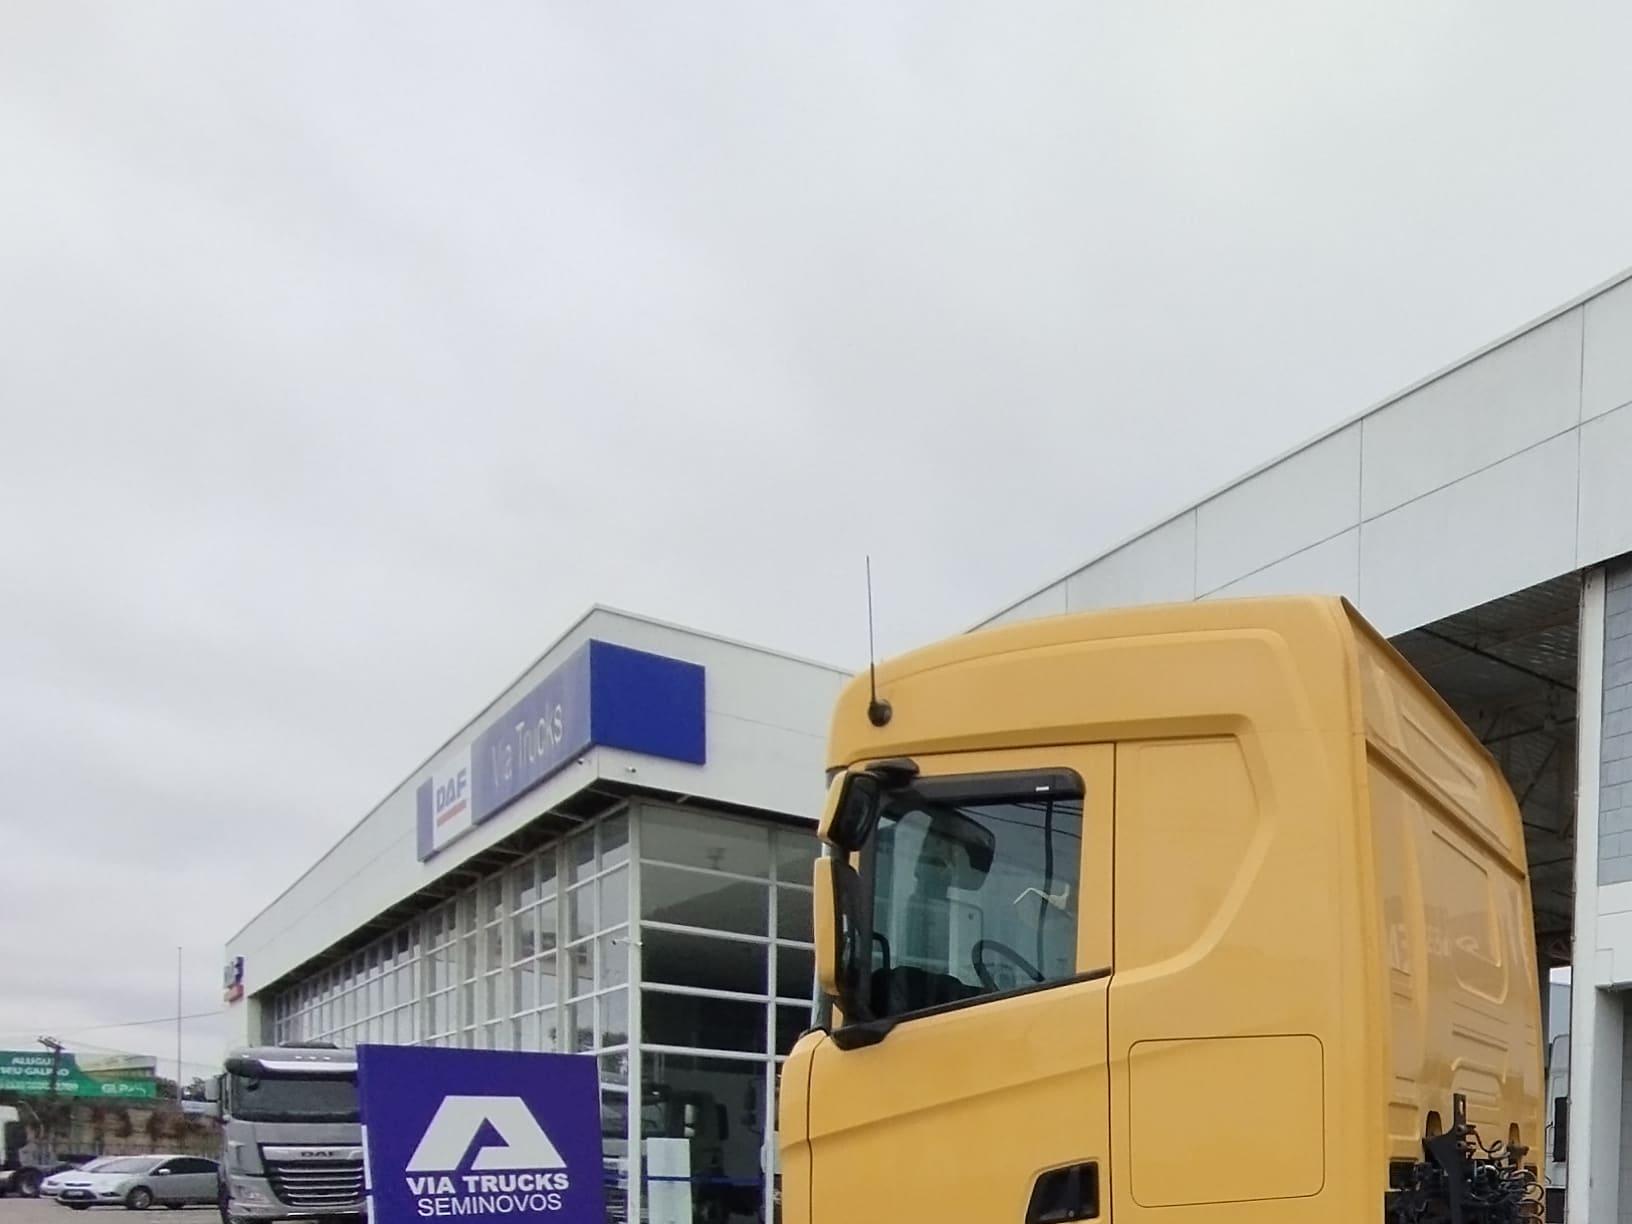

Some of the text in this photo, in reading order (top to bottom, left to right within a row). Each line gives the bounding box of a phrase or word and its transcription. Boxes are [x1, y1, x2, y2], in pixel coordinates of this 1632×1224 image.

[436, 768, 467, 812] DAF
[24, 1067, 70, 1077] GALPO
[407, 1173, 570, 1196] VIA TRUCKS
[417, 1193, 562, 1217] SEMINOVOS
